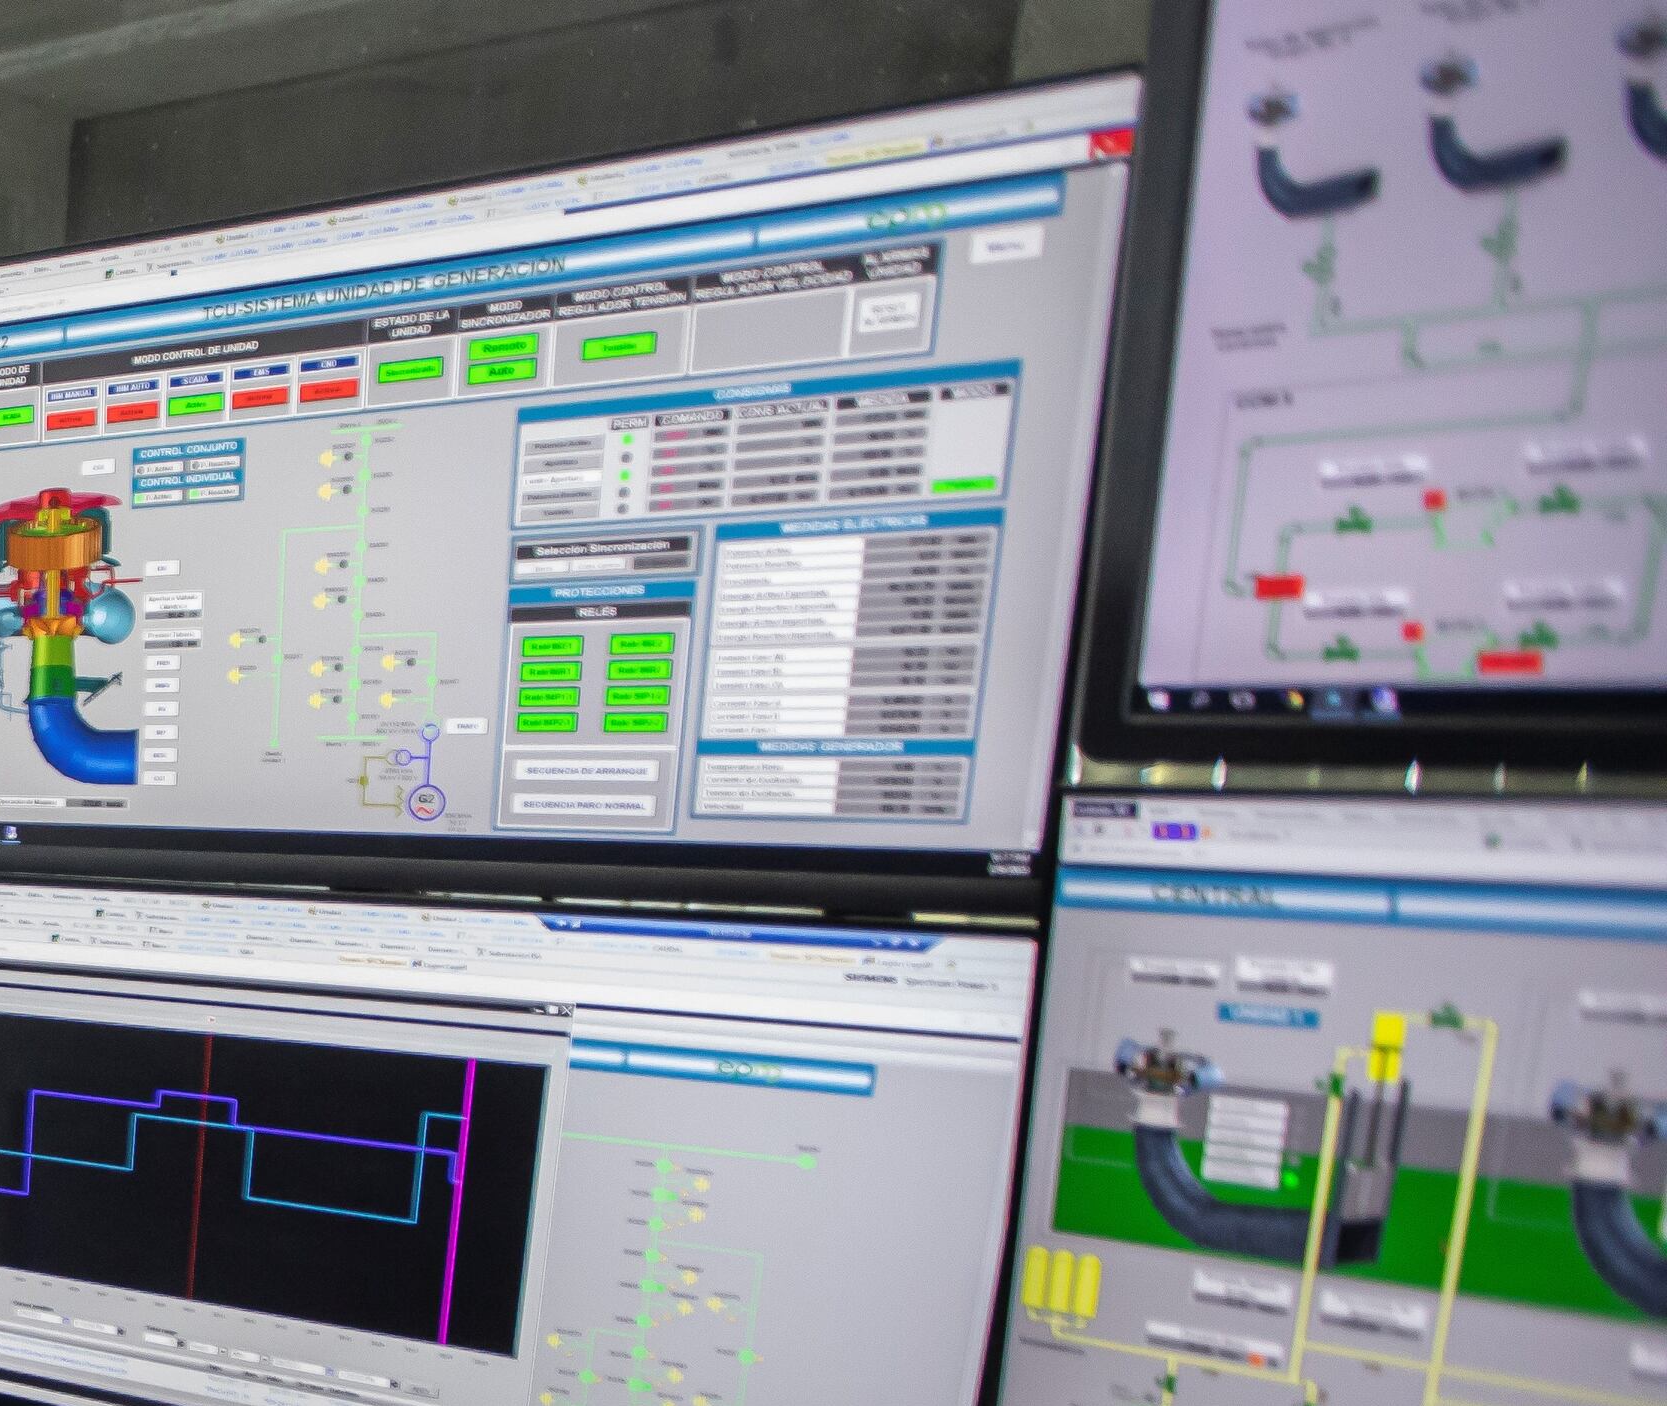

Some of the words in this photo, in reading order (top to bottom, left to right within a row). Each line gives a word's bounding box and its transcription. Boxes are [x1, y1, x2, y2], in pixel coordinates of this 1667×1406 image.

[203, 292, 319, 321] TCU-SISTEMA
[325, 282, 394, 305] UNIDAD
[401, 276, 425, 293] DE
[432, 255, 566, 290] GENERACIÓN
[576, 289, 610, 302] MODO
[613, 281, 668, 298] CONTROL
[488, 300, 523, 313] MODO
[373, 313, 416, 329] ESTADO
[418, 311, 433, 324] DE
[435, 310, 450, 322] LA
[462, 309, 551, 329] SINCRONIZADOR
[390, 325, 431, 338] UNIDAD
[1, 336, 9, 348] 2
[133, 353, 160, 365] MODO
[162, 348, 205, 361] CONTROL
[208, 346, 220, 357] DE
[223, 341, 259, 354] UNIDAD
[18, 364, 30, 375] DE
[141, 447, 184, 458] CONTROL
[187, 441, 238, 453] CONJUNTO
[141, 476, 184, 487] CONTROL
[186, 472, 236, 483] INDIVIDUAL
